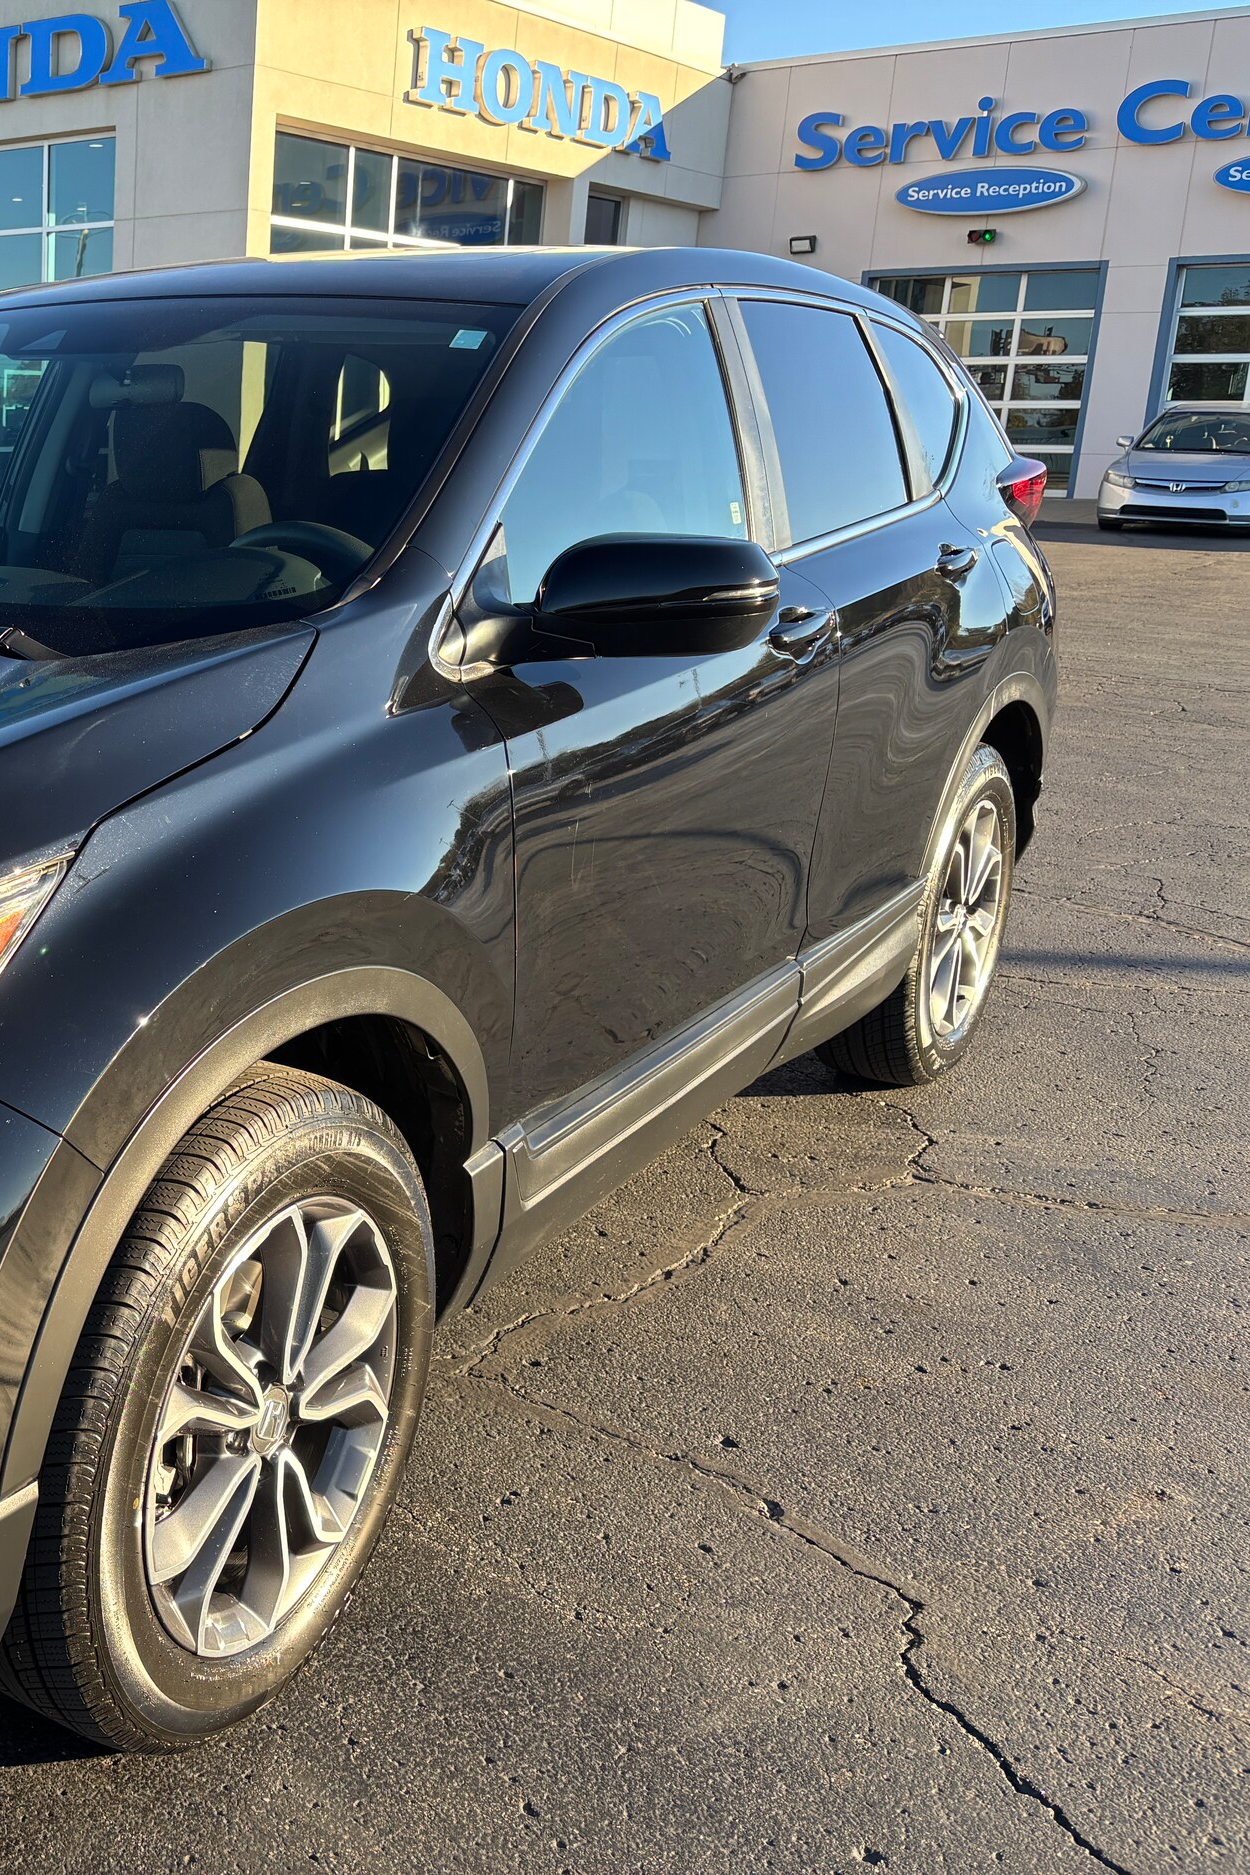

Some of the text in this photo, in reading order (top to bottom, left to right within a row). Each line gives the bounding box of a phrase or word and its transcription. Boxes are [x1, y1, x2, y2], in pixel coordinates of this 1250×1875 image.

[410, 26, 671, 162] HONDA
[794, 78, 1250, 171] Service Ce
[907, 179, 1067, 200] Service Reception
